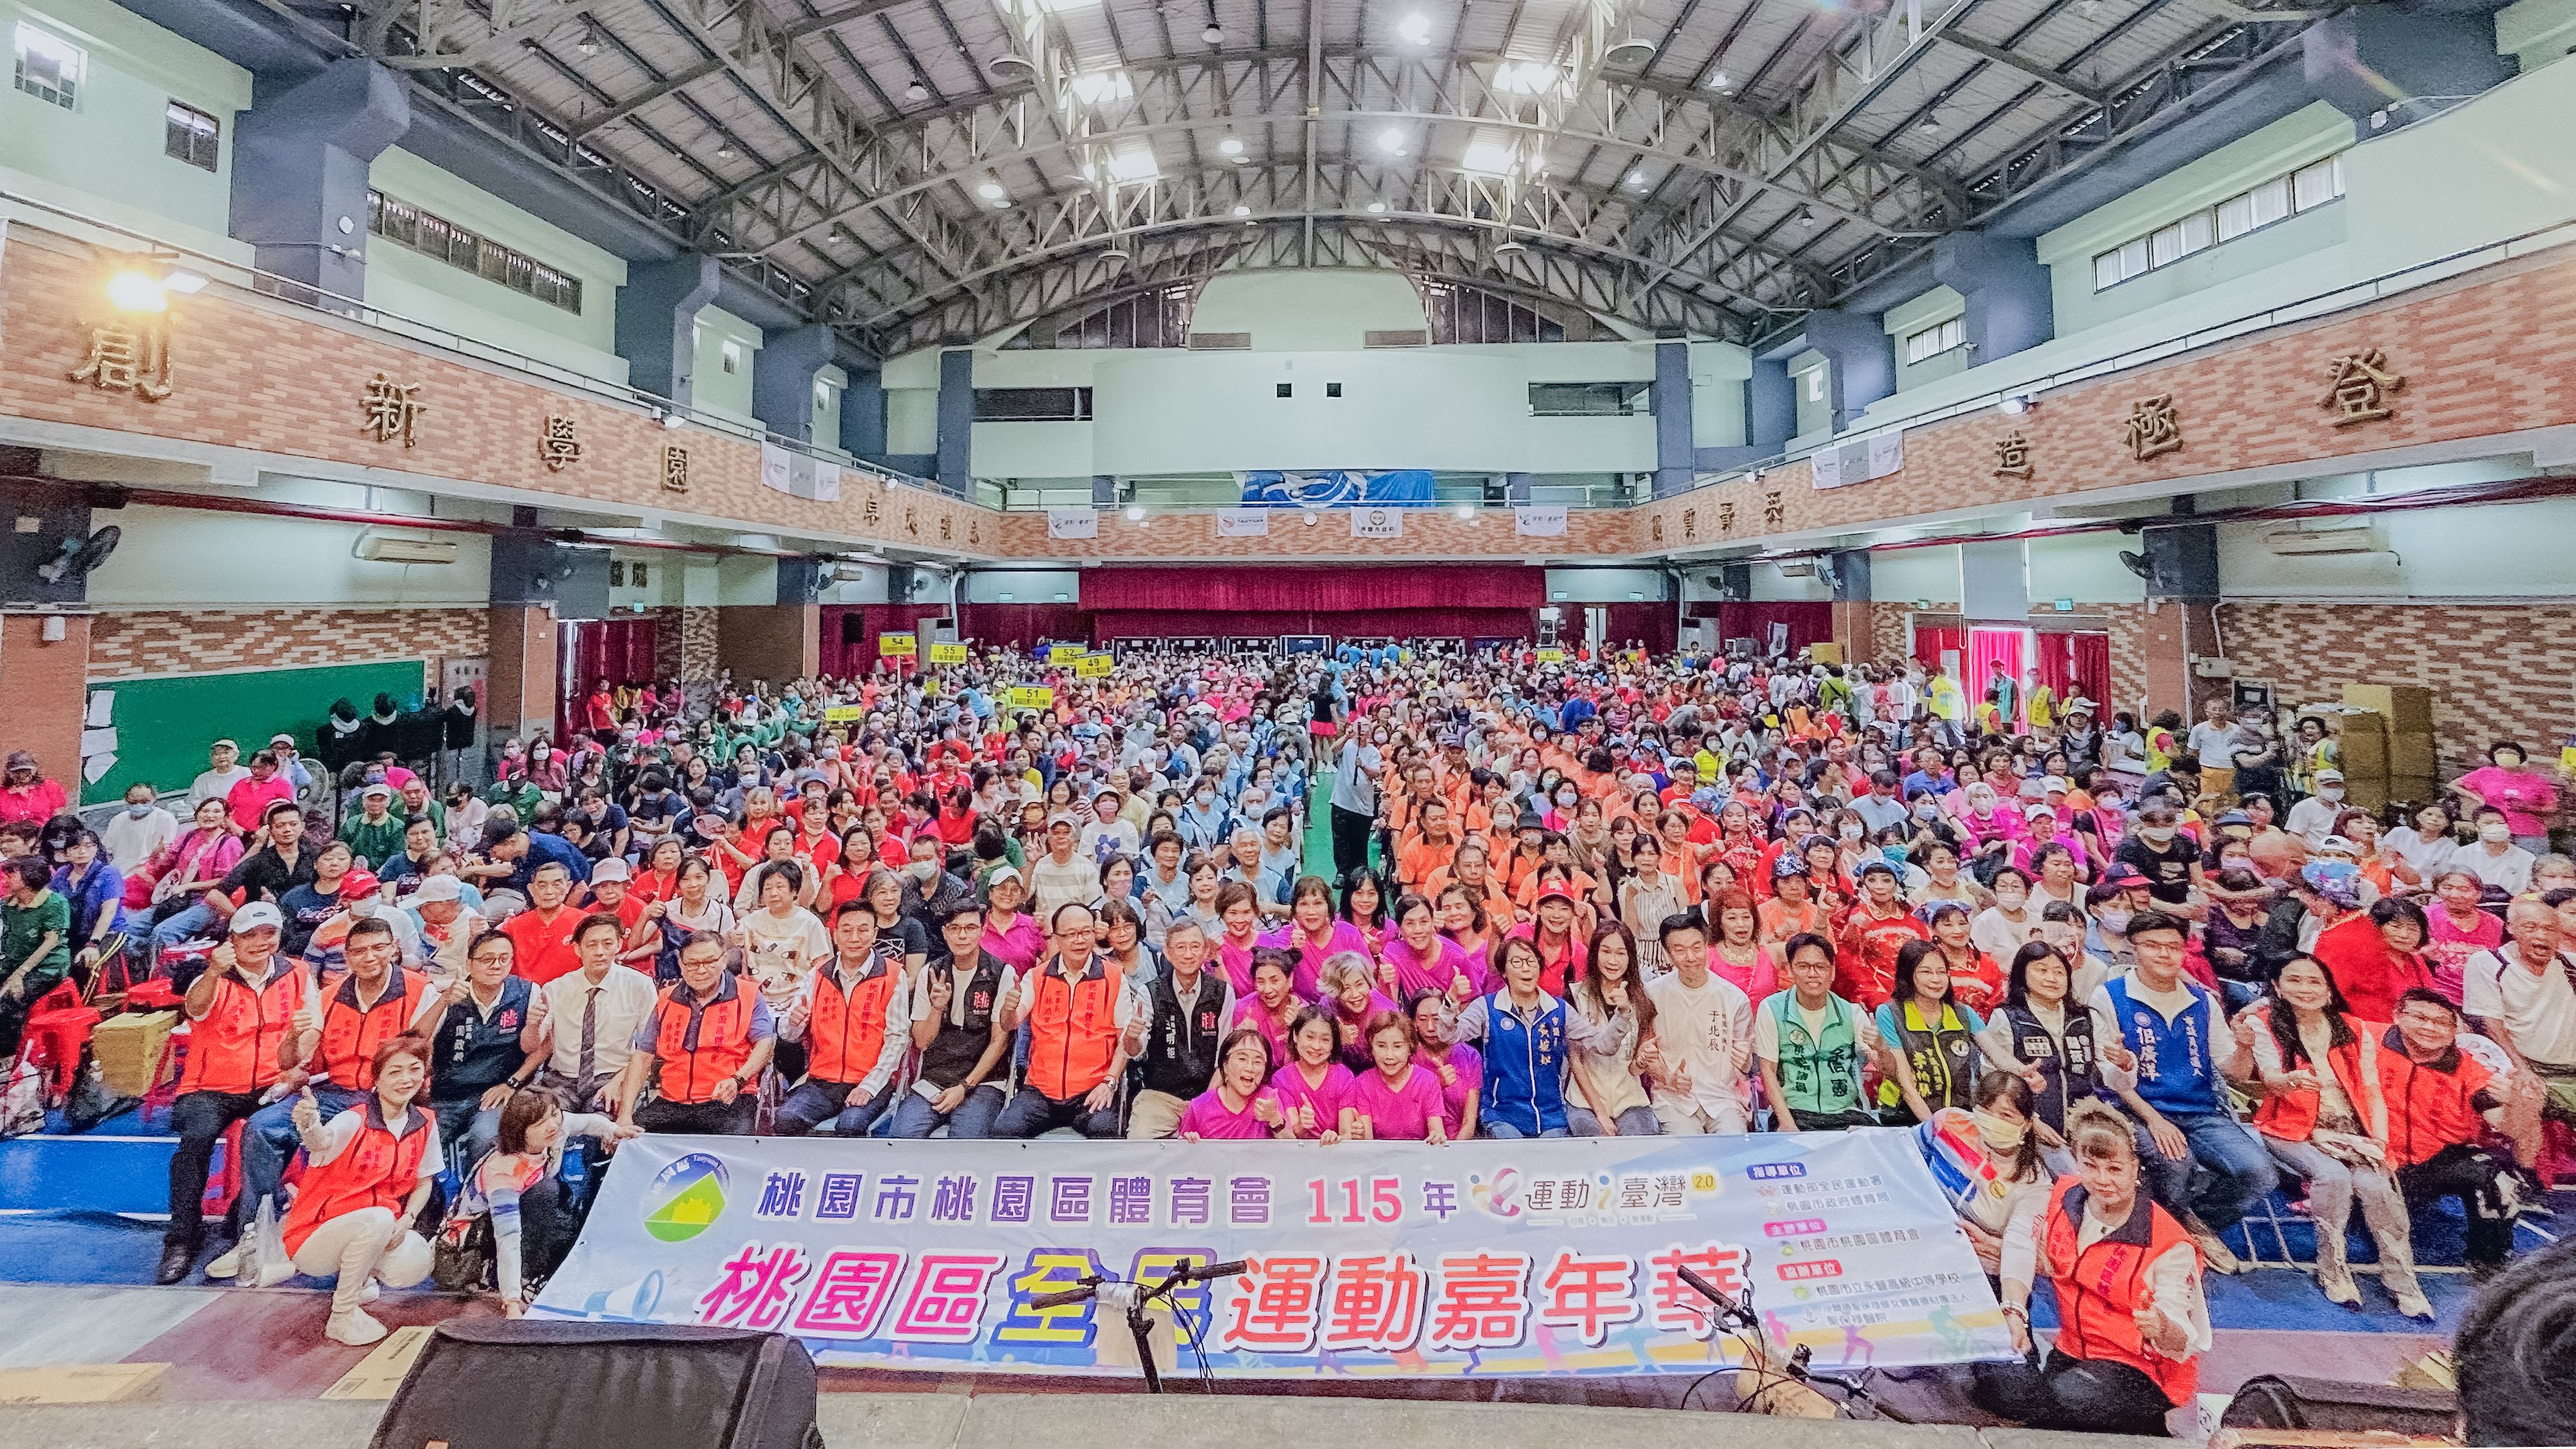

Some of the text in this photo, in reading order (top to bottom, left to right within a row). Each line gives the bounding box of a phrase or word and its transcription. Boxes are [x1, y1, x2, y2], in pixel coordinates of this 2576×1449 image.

[943, 646, 956, 654] 55
[1088, 658, 1099, 666] 49
[1027, 689, 1039, 698] 51
[1708, 1010, 1720, 1051] 于北辰
[1695, 1175, 1714, 1188] 2.0
[758, 1172, 1457, 1224] 桃園市桃園區體育會 115 年
